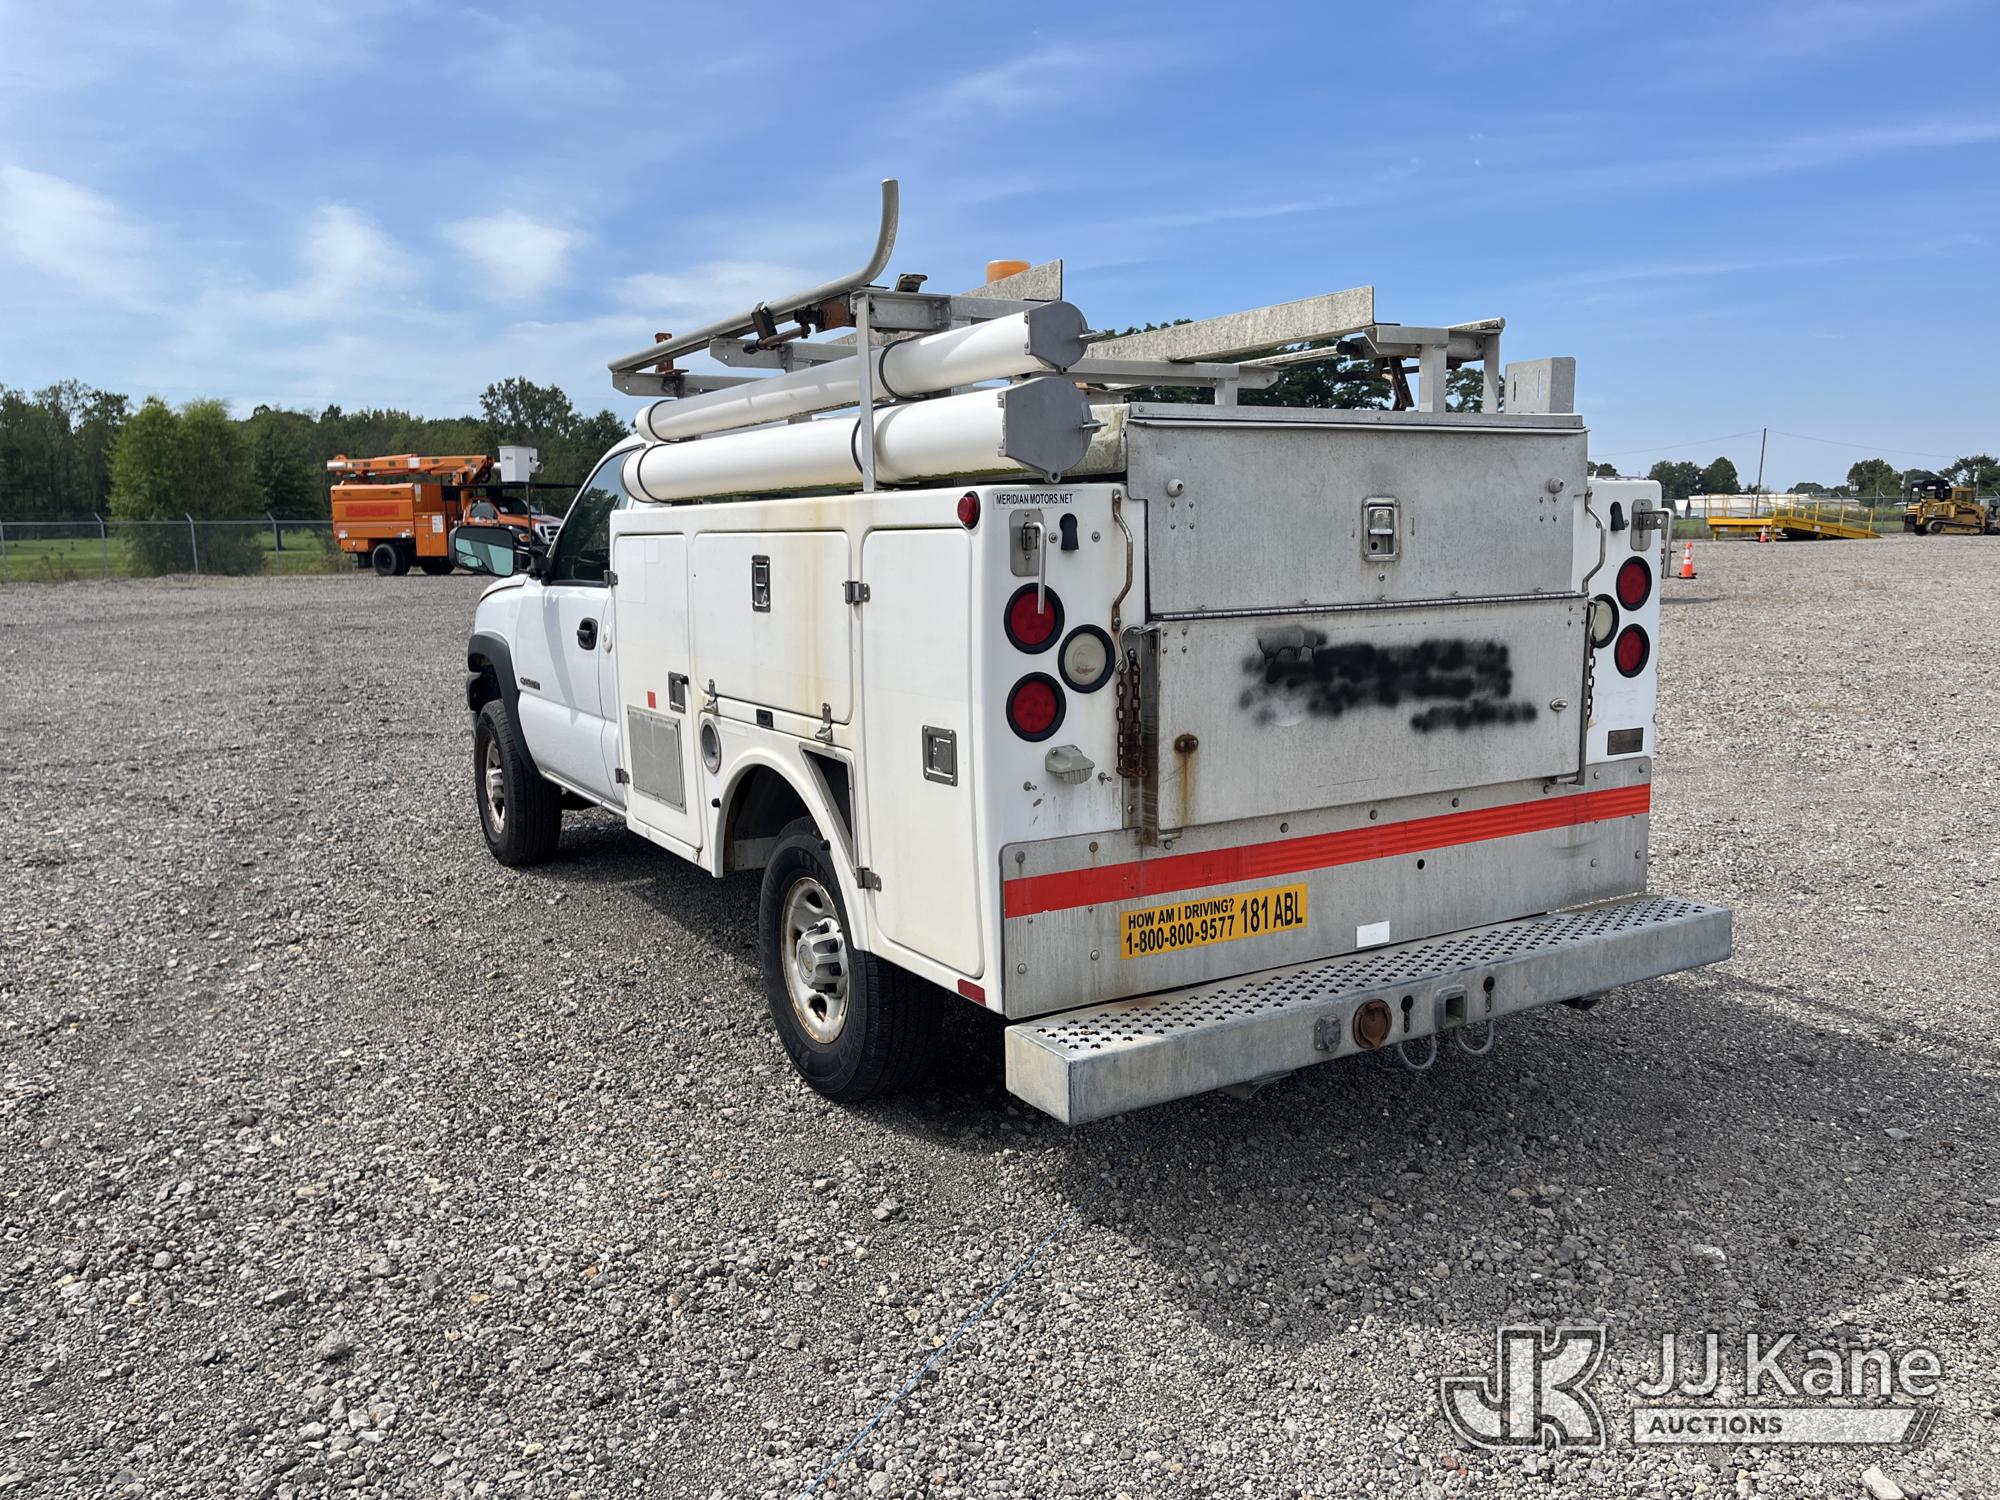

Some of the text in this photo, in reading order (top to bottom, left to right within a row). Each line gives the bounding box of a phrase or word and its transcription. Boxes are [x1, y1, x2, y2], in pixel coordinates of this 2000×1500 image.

[996, 493, 1029, 505] MERIDIAN
[1128, 898, 1235, 930] HOW AM I DRIVING?
[1240, 891, 1303, 934] 181 ABL
[1126, 914, 1235, 955] 1-800-800-9577
